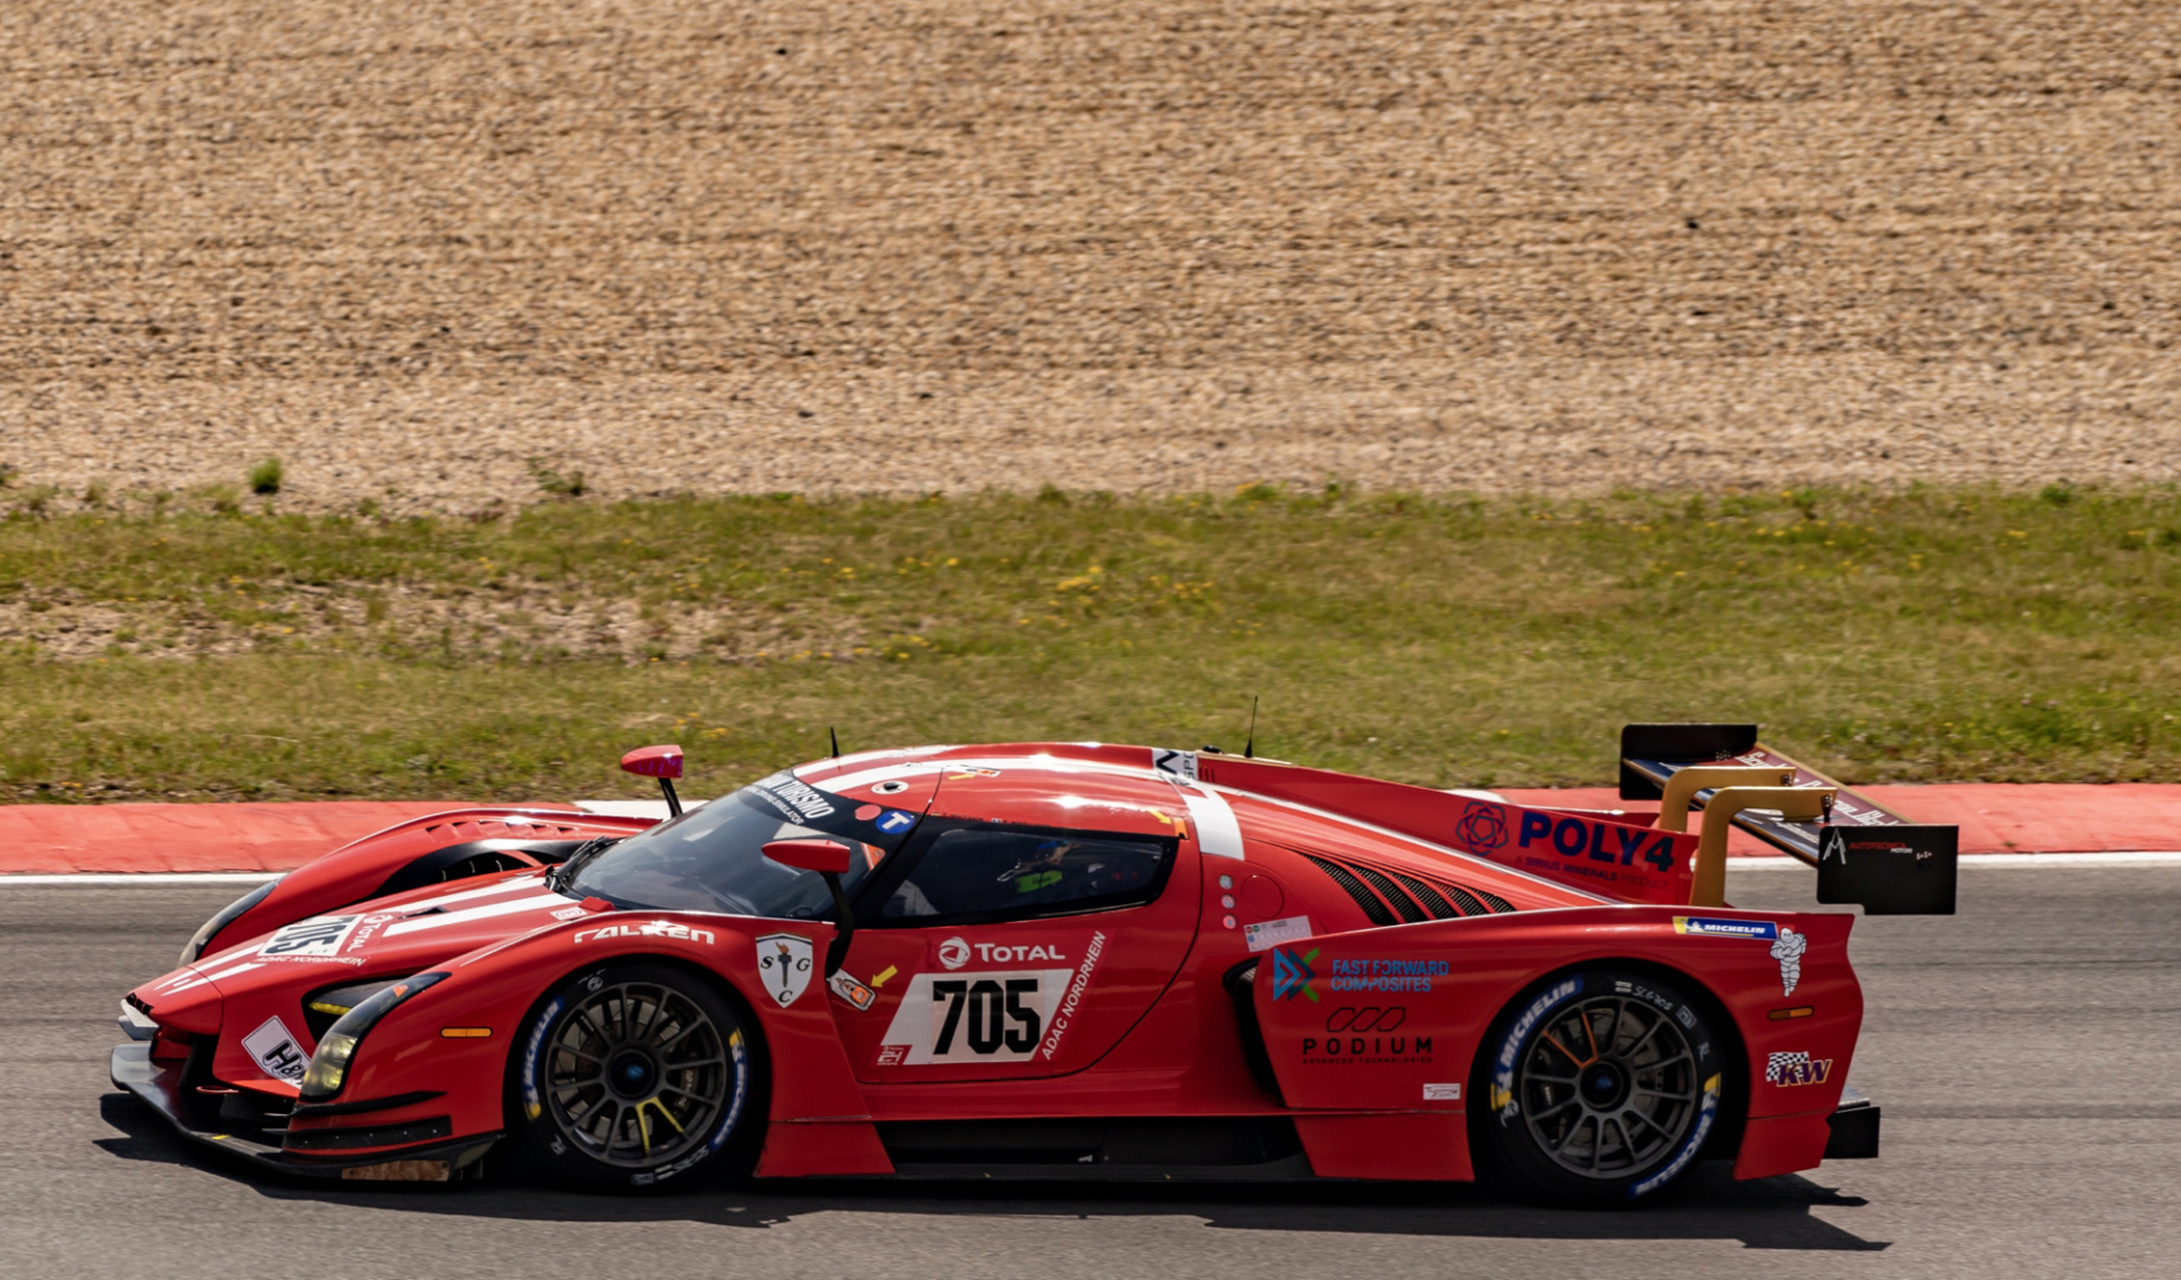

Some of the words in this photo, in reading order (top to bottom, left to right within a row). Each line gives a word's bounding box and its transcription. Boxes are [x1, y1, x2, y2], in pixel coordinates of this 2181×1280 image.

[1518, 811, 1674, 872] POLY4
[1563, 863, 1618, 882] MINERALS
[264, 914, 358, 954] 705
[574, 921, 715, 945] FALKEN
[1704, 924, 1766, 934] MICHELIN
[974, 943, 1066, 962] TOTAL
[1332, 959, 1370, 975] FAST
[1372, 960, 1449, 976] FORWARD
[1041, 1017, 1068, 1060] ADAC
[1062, 930, 1106, 1017] NORDRHEIN
[1331, 976, 1431, 992] COMPOSITES
[932, 978, 1041, 1055] 705
[1500, 980, 1576, 1068] MICHELIN
[1303, 1037, 1432, 1055] PODIUM
[1776, 1059, 1833, 1088] KW
